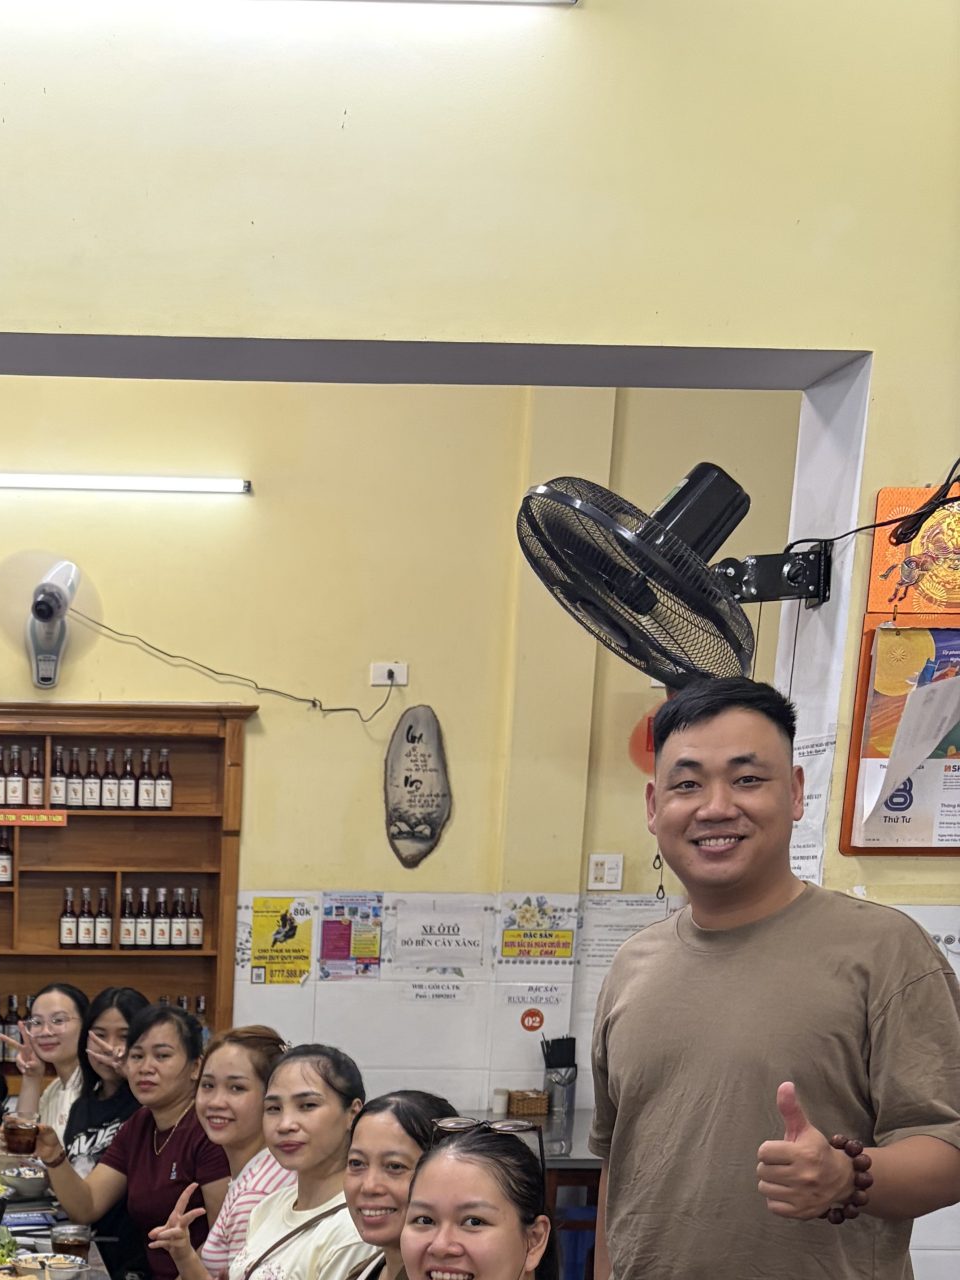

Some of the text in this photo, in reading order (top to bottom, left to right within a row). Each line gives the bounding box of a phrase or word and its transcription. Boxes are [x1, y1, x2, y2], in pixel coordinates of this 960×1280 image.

[883, 815, 912, 824] Thứ Tư
[421, 923, 460, 934] XE ÔTÔ
[523, 1016, 541, 1027] 02
